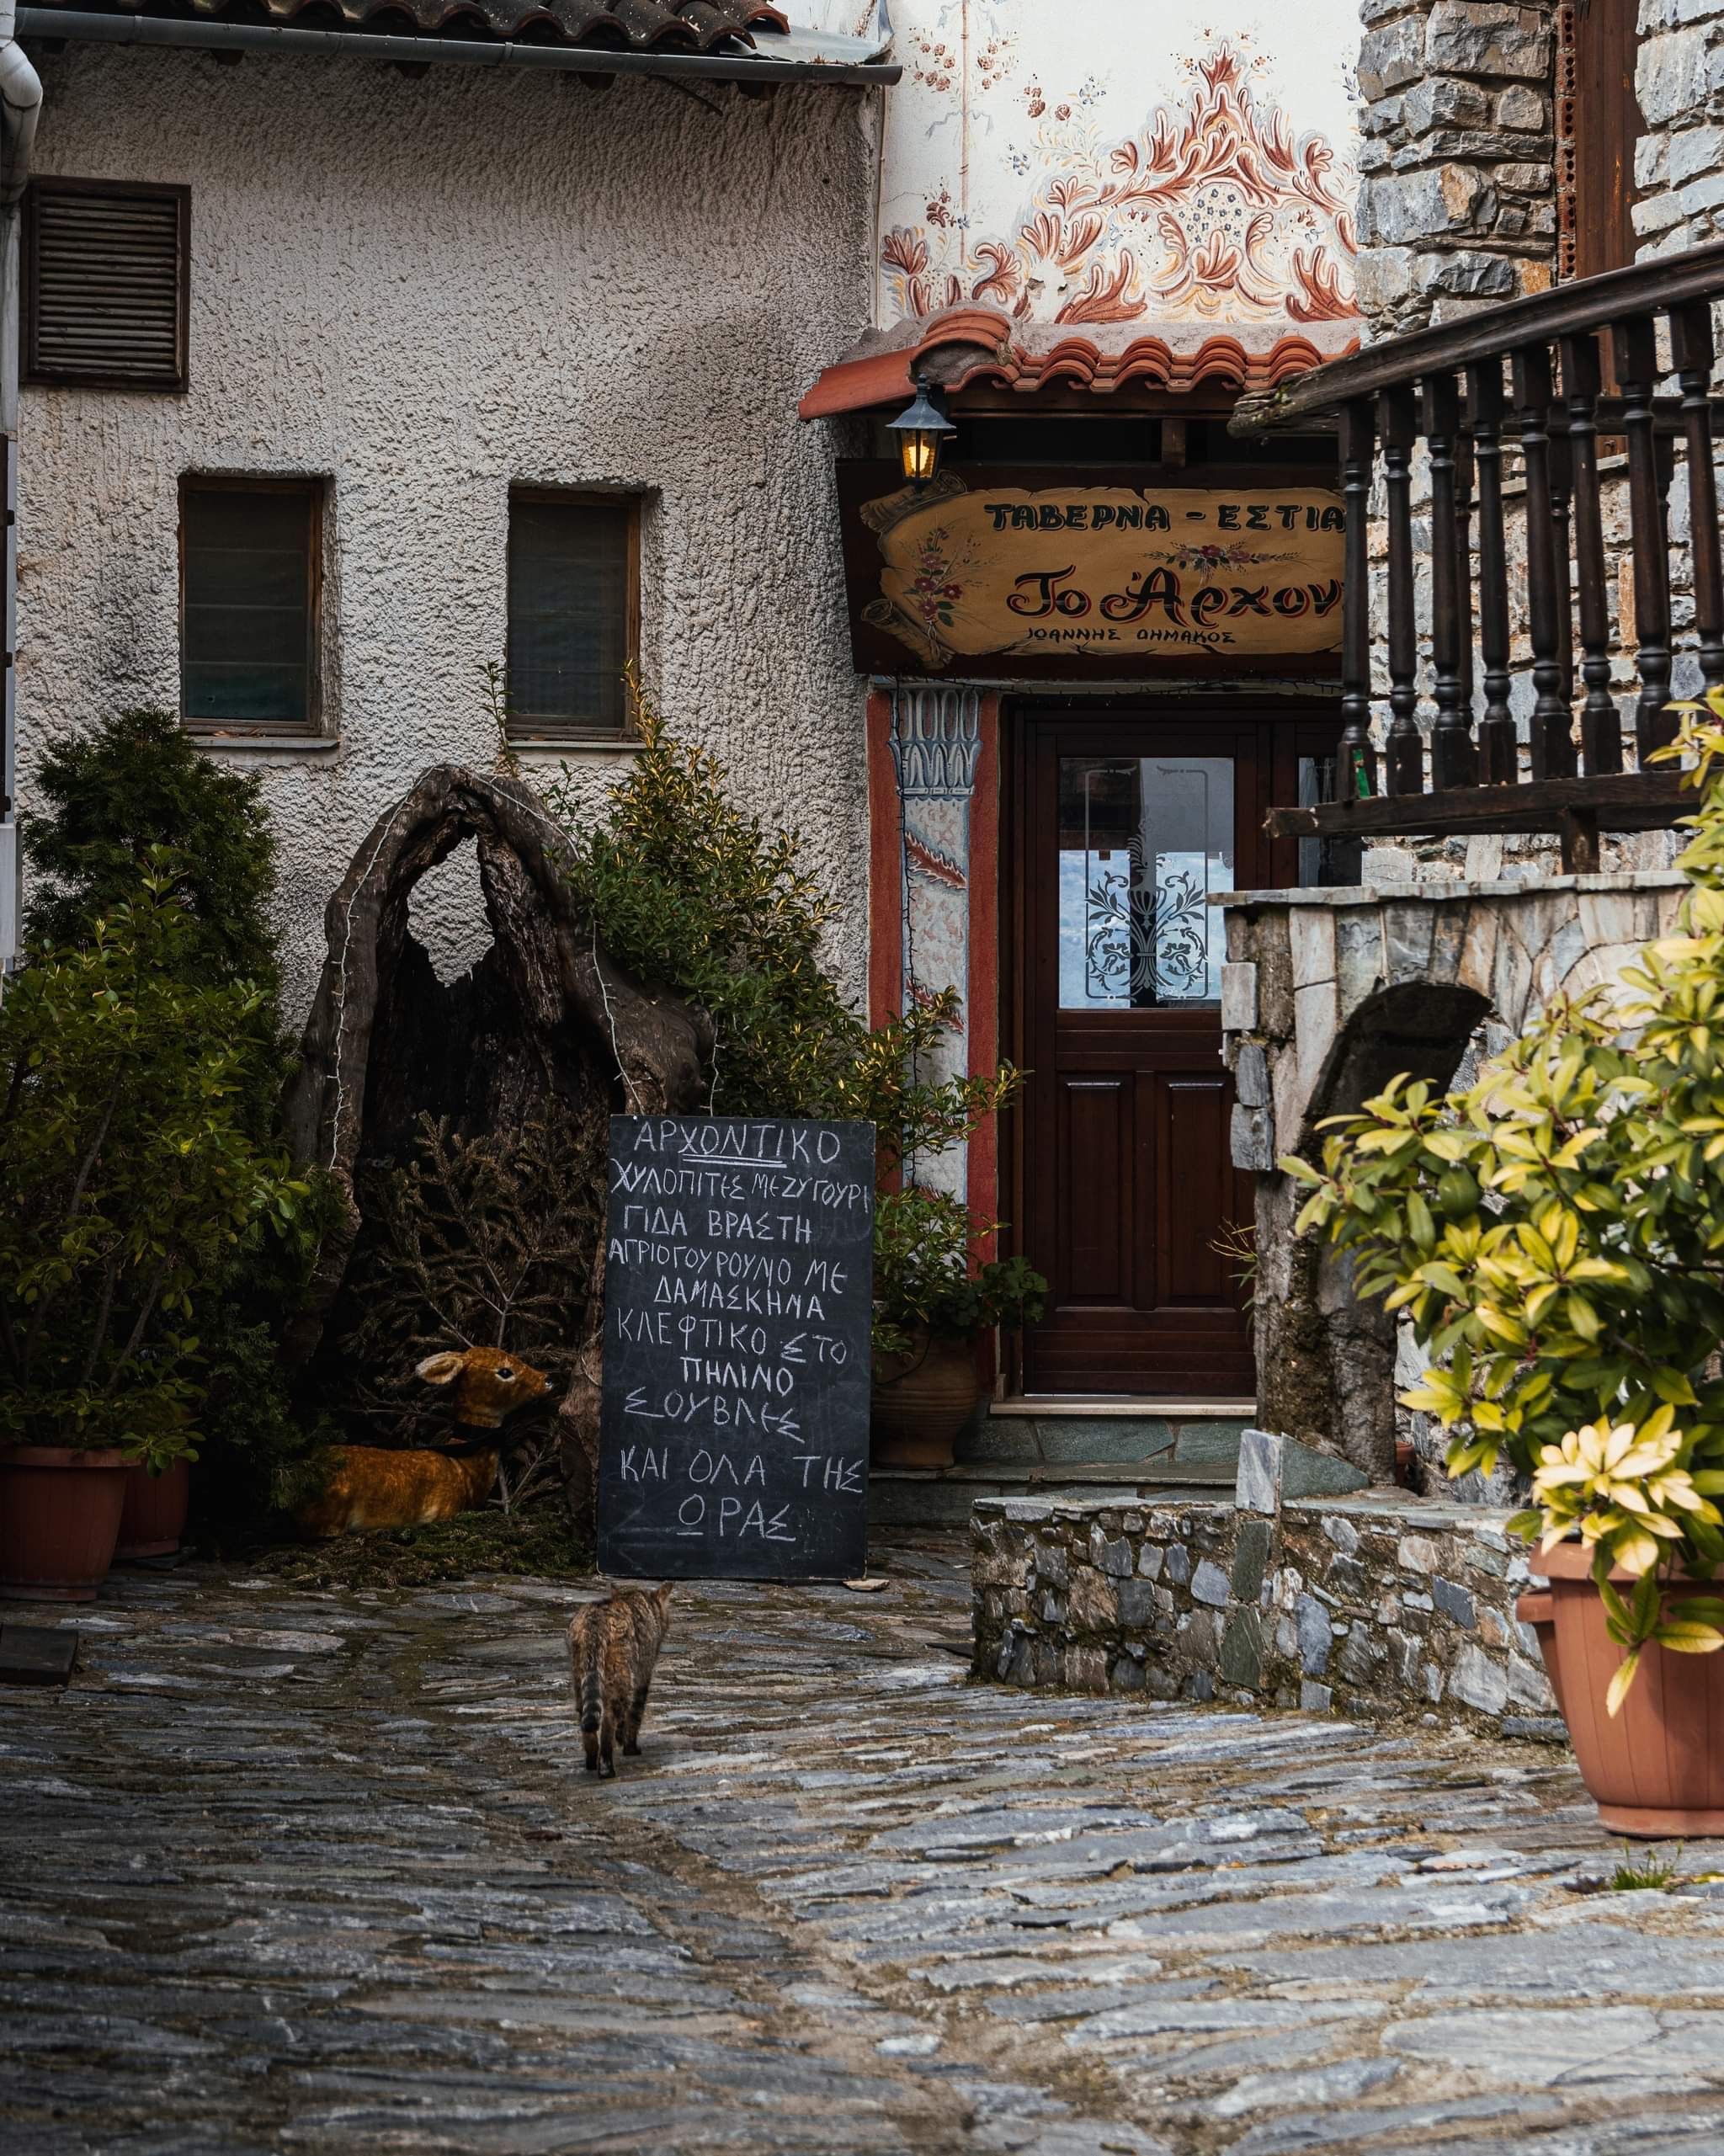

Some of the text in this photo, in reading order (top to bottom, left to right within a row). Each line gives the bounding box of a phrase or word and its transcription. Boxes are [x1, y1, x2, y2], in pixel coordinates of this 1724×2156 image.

[984, 503, 1170, 531] ΤΑΒΕΡΝΑ
[634, 1120, 841, 1163] ΑΡΧΟΝΤΙΚΟ
[610, 1158, 745, 1200] ΧΥΛΟΠΙΤΕΣ
[624, 1205, 812, 1244] ΓΙΔΑ ΒΡΑΣΤΗ
[654, 1275, 825, 1320] ΔΑΜΑΣΚΗΝΑ
[804, 1259, 848, 1294] ΜΕ
[617, 1307, 847, 1364] ΚΛΕΦΤΙΚΟ ΣΤΟ
[680, 1356, 794, 1397] ΠΗΛΙΝΟ
[624, 1387, 806, 1444] ΣΟΥΒΛΕΣ
[620, 1445, 864, 1493] ΚΑΙ ΟΛΑ ΤΗΣ
